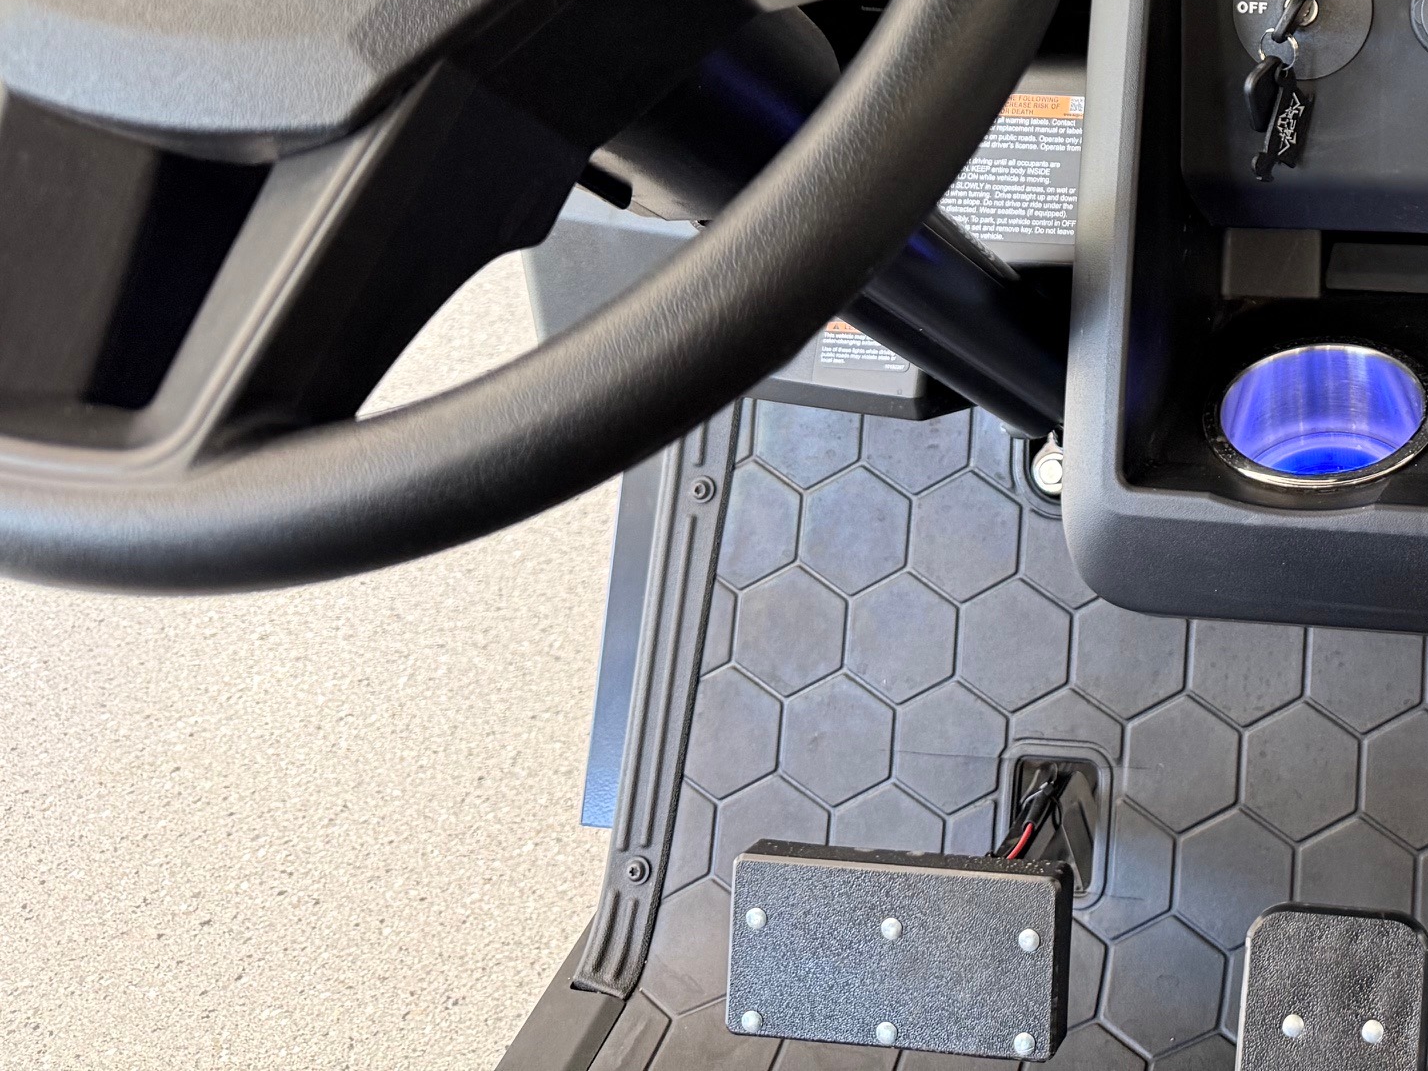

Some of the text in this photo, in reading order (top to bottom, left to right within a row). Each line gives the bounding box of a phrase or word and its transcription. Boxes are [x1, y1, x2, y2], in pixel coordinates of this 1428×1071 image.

[1236, 1, 1268, 14] OFF
[1019, 95, 1059, 103] FOLLOWING
[992, 166, 1009, 174] entire
[1010, 167, 1026, 176] body
[1027, 168, 1051, 176] INSIDE
